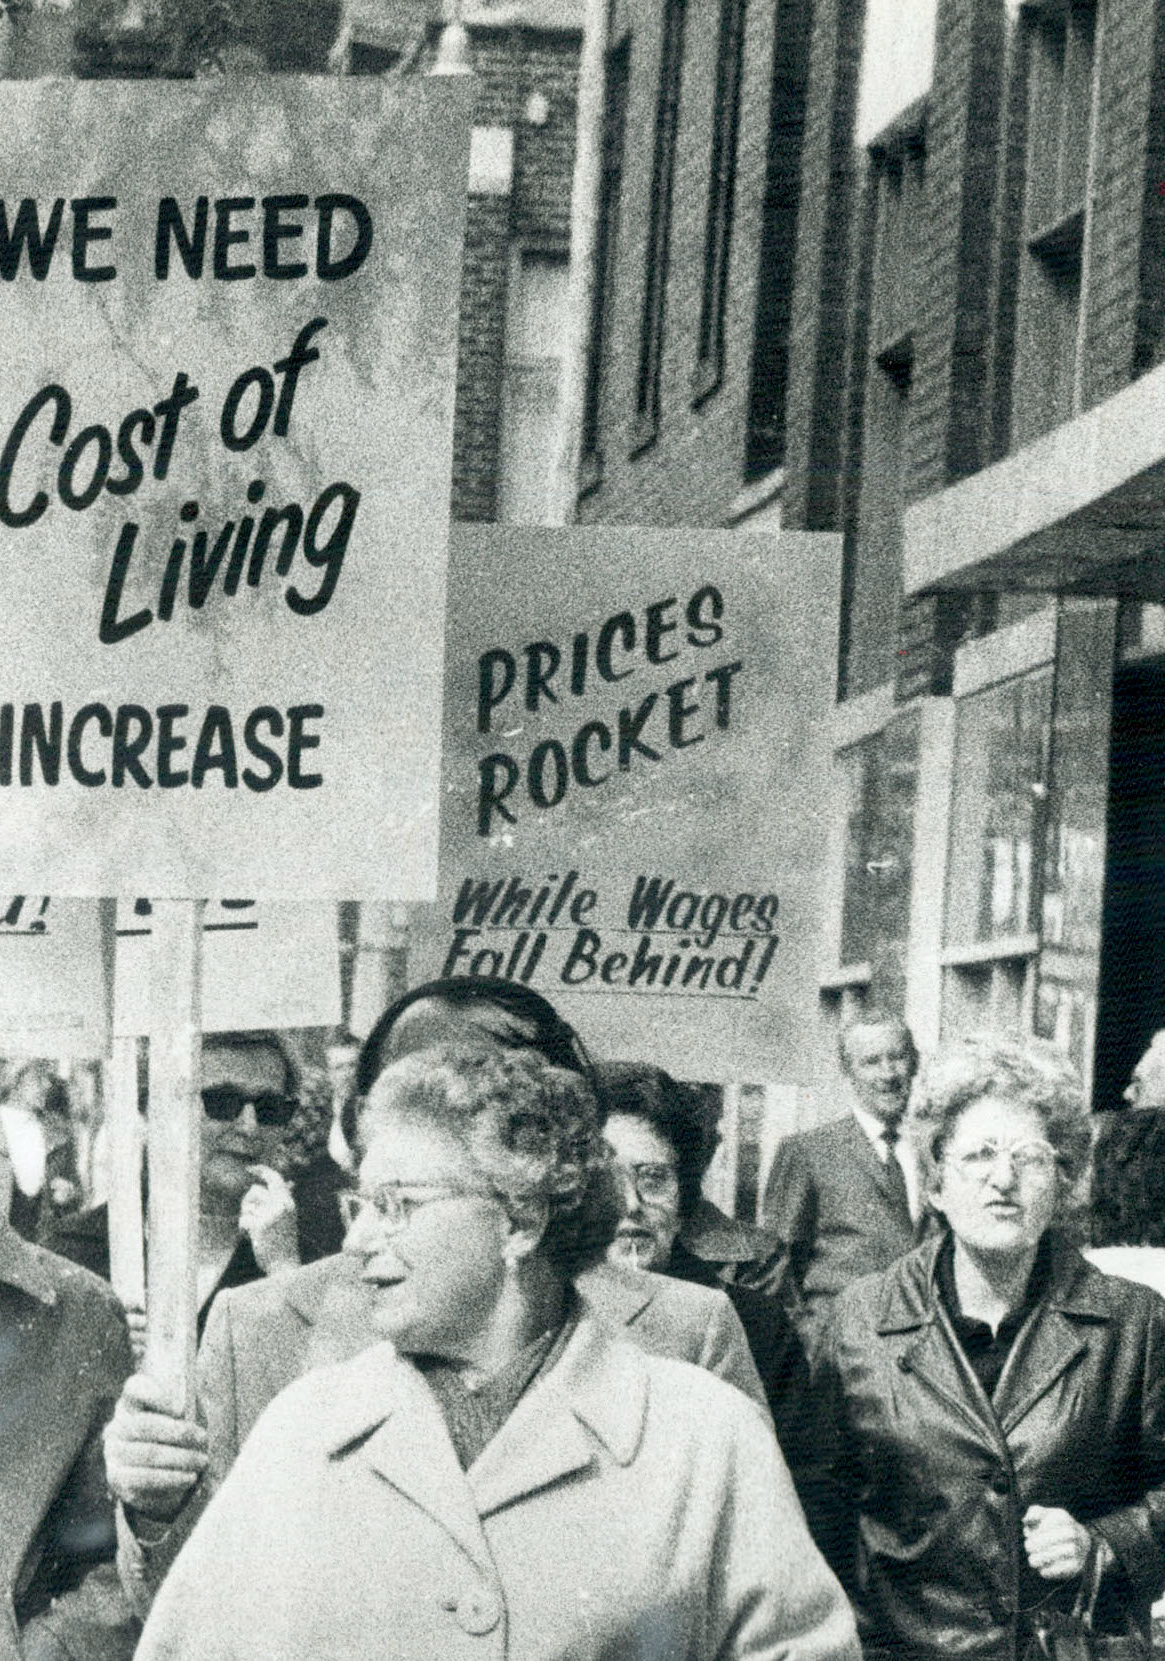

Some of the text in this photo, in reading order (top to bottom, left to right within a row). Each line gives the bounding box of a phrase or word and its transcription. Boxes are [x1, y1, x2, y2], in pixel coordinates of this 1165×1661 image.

[154, 193, 375, 282] NEED
[220, 317, 329, 451] of
[98, 479, 362, 644] Living
[477, 585, 724, 734] PRICES
[477, 661, 743, 837] ROCKET
[442, 929, 780, 993] Fall Behind!
[452, 870, 780, 948] While Wages
